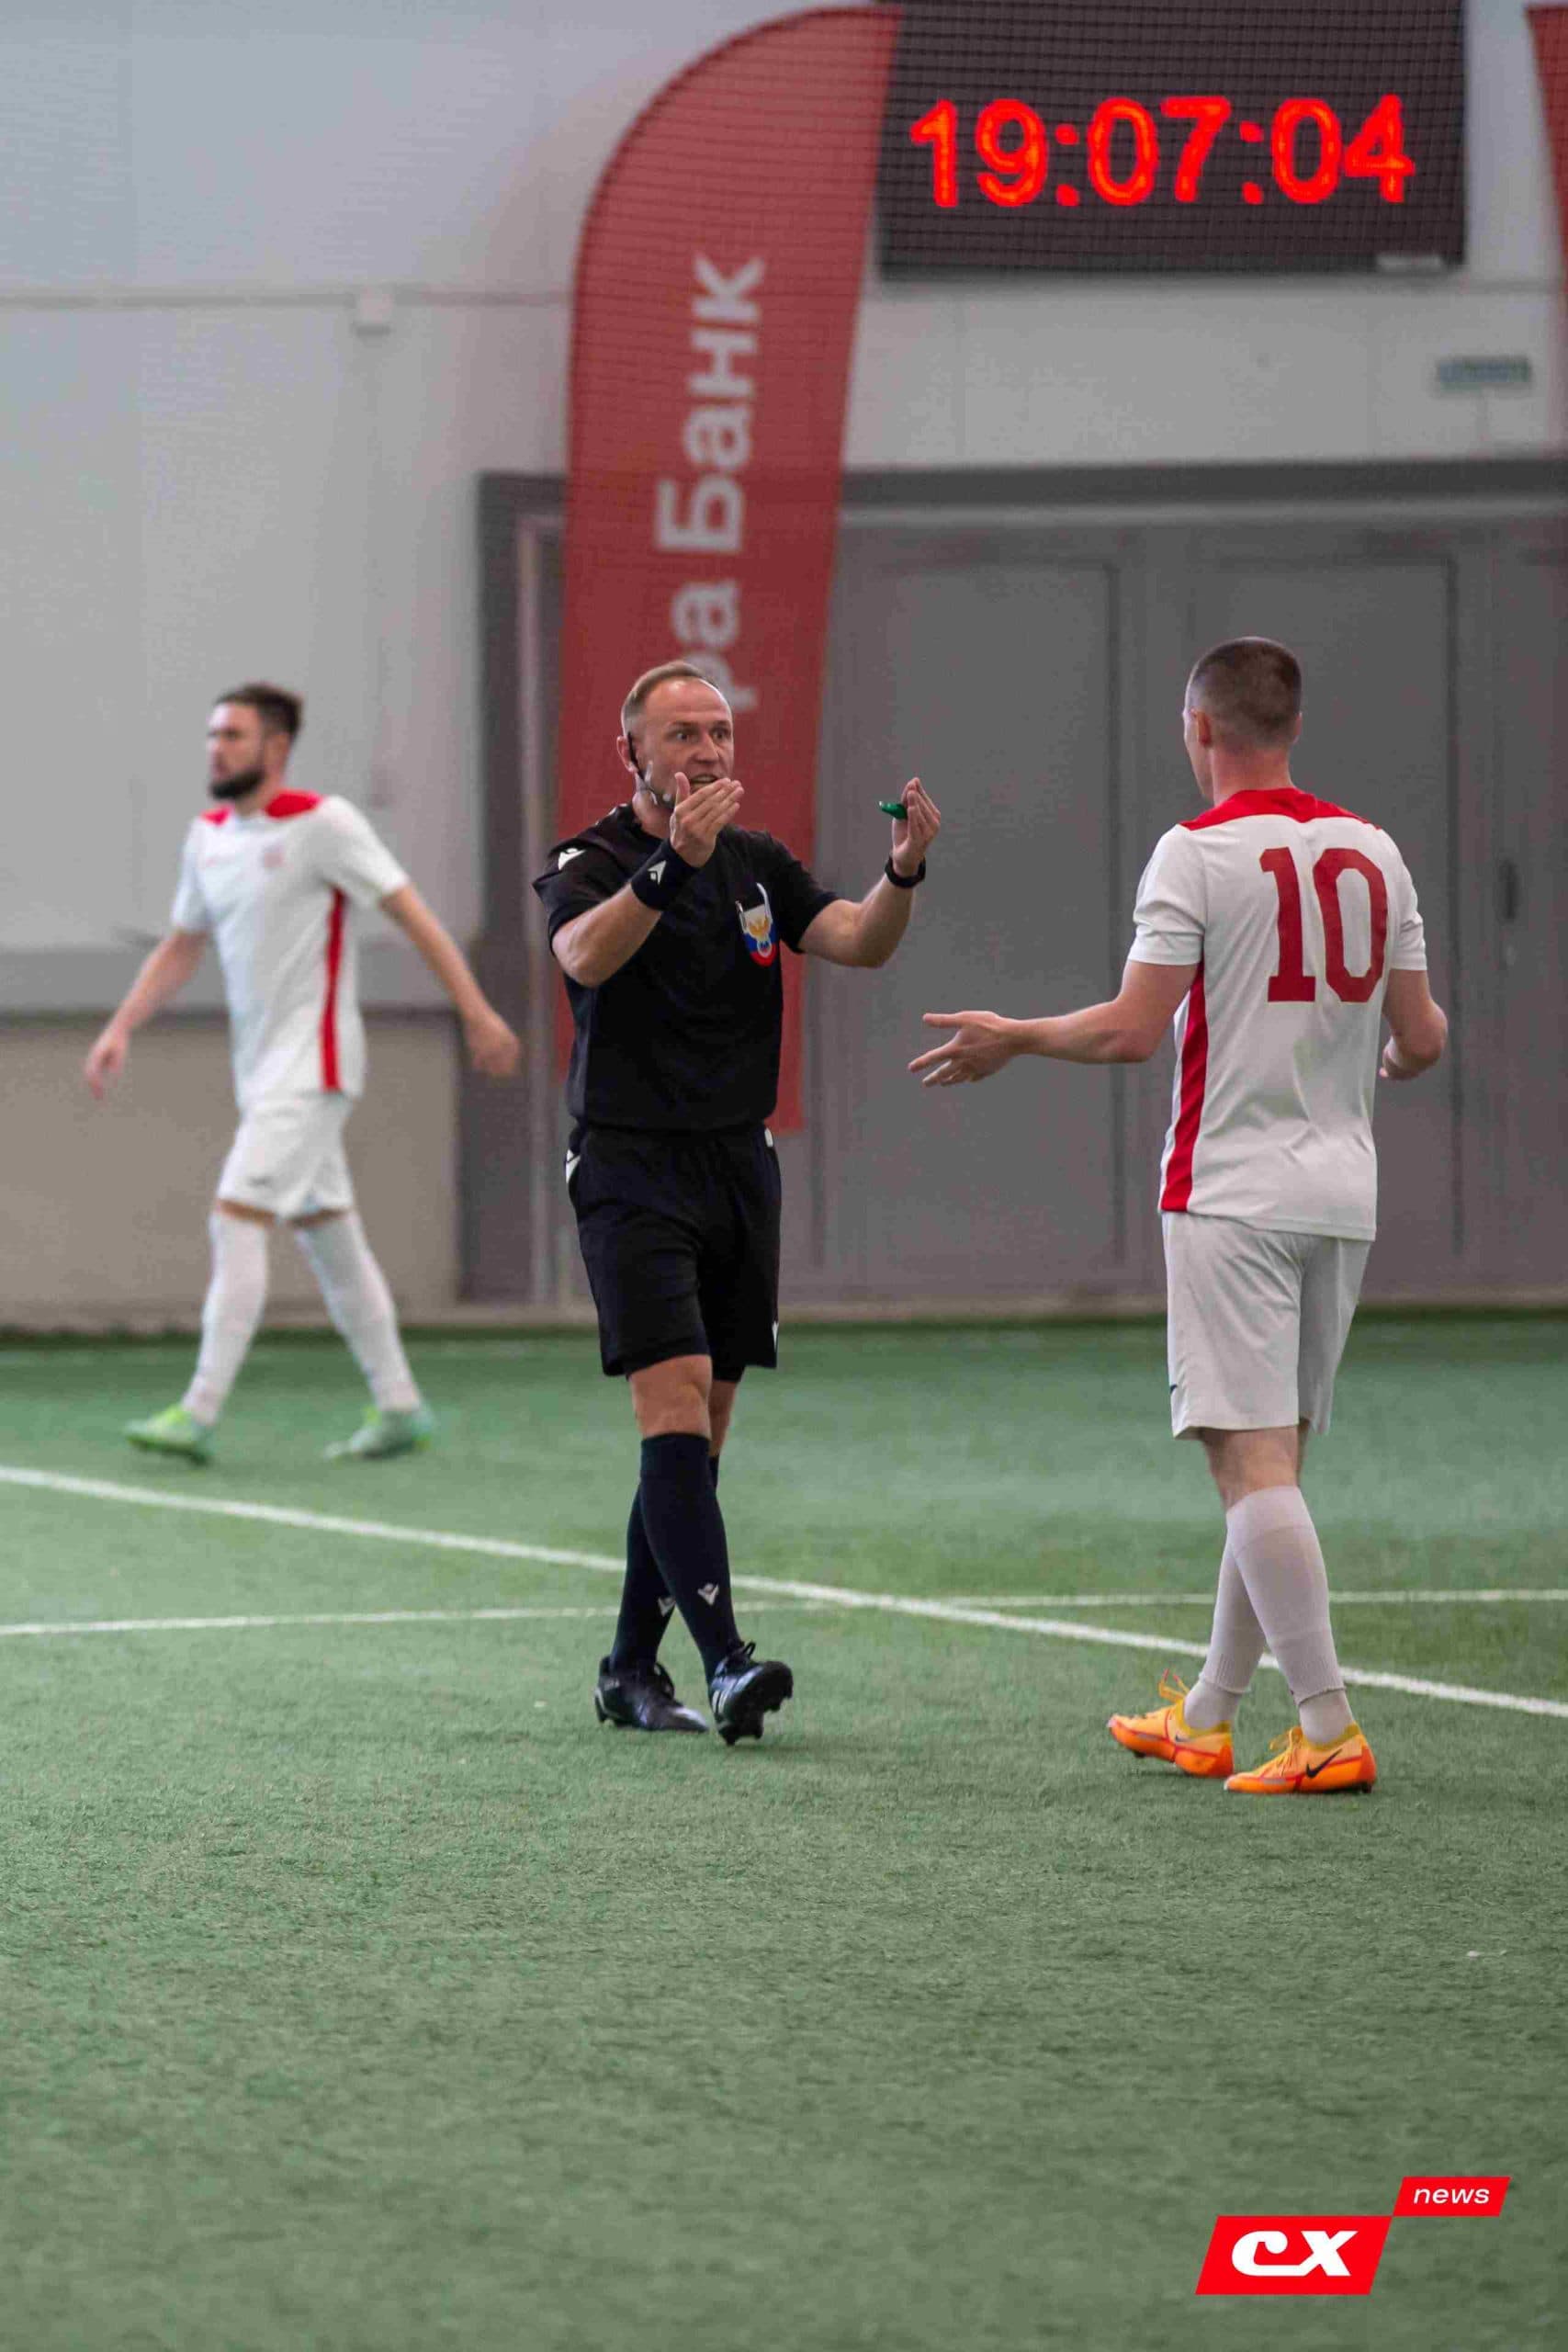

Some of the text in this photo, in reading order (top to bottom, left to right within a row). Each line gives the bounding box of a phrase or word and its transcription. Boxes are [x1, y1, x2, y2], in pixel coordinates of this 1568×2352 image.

[910, 94, 1416, 207] 19:07:04
[654, 254, 766, 553] Банк
[1258, 846, 1388, 1002] 10
